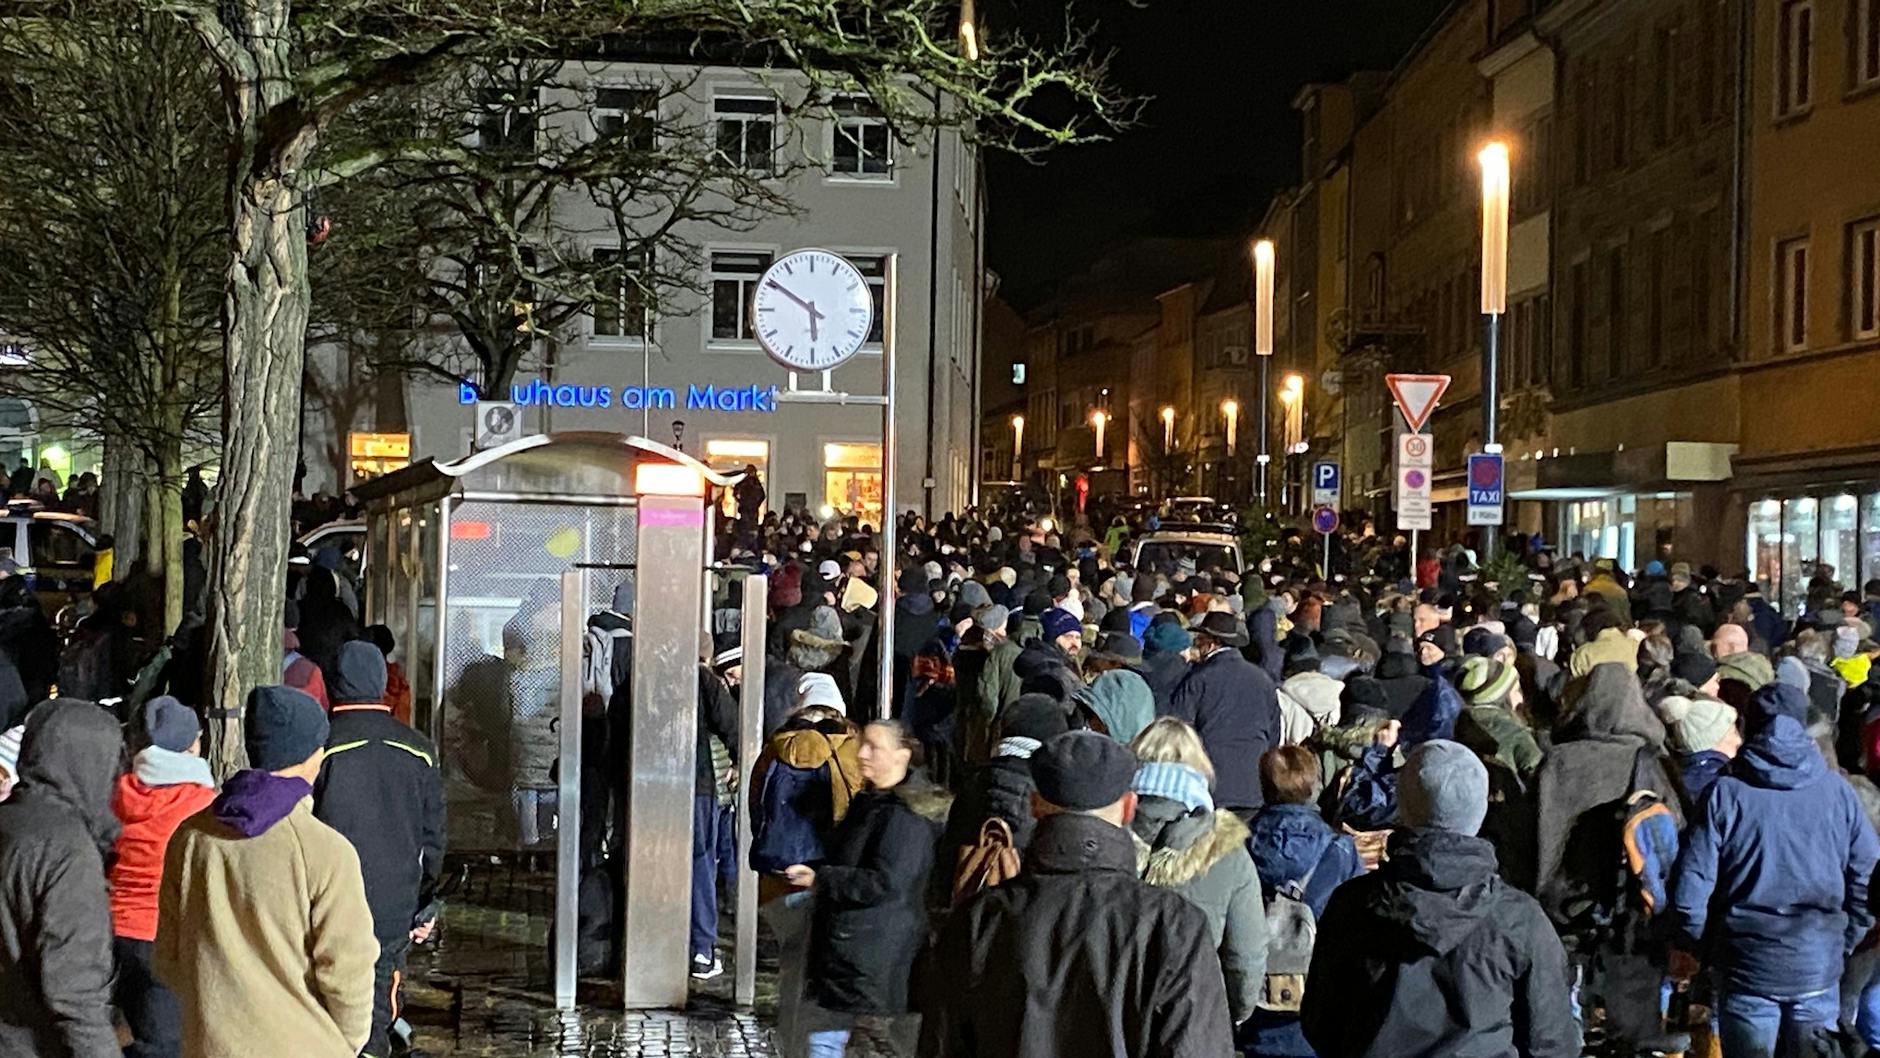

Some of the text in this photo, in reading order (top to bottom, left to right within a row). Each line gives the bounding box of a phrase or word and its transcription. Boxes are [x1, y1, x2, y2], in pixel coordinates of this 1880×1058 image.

[458, 378, 778, 412] Buhaus am Markt
[1319, 464, 1335, 487] P
[1471, 489, 1500, 504] TAXI
